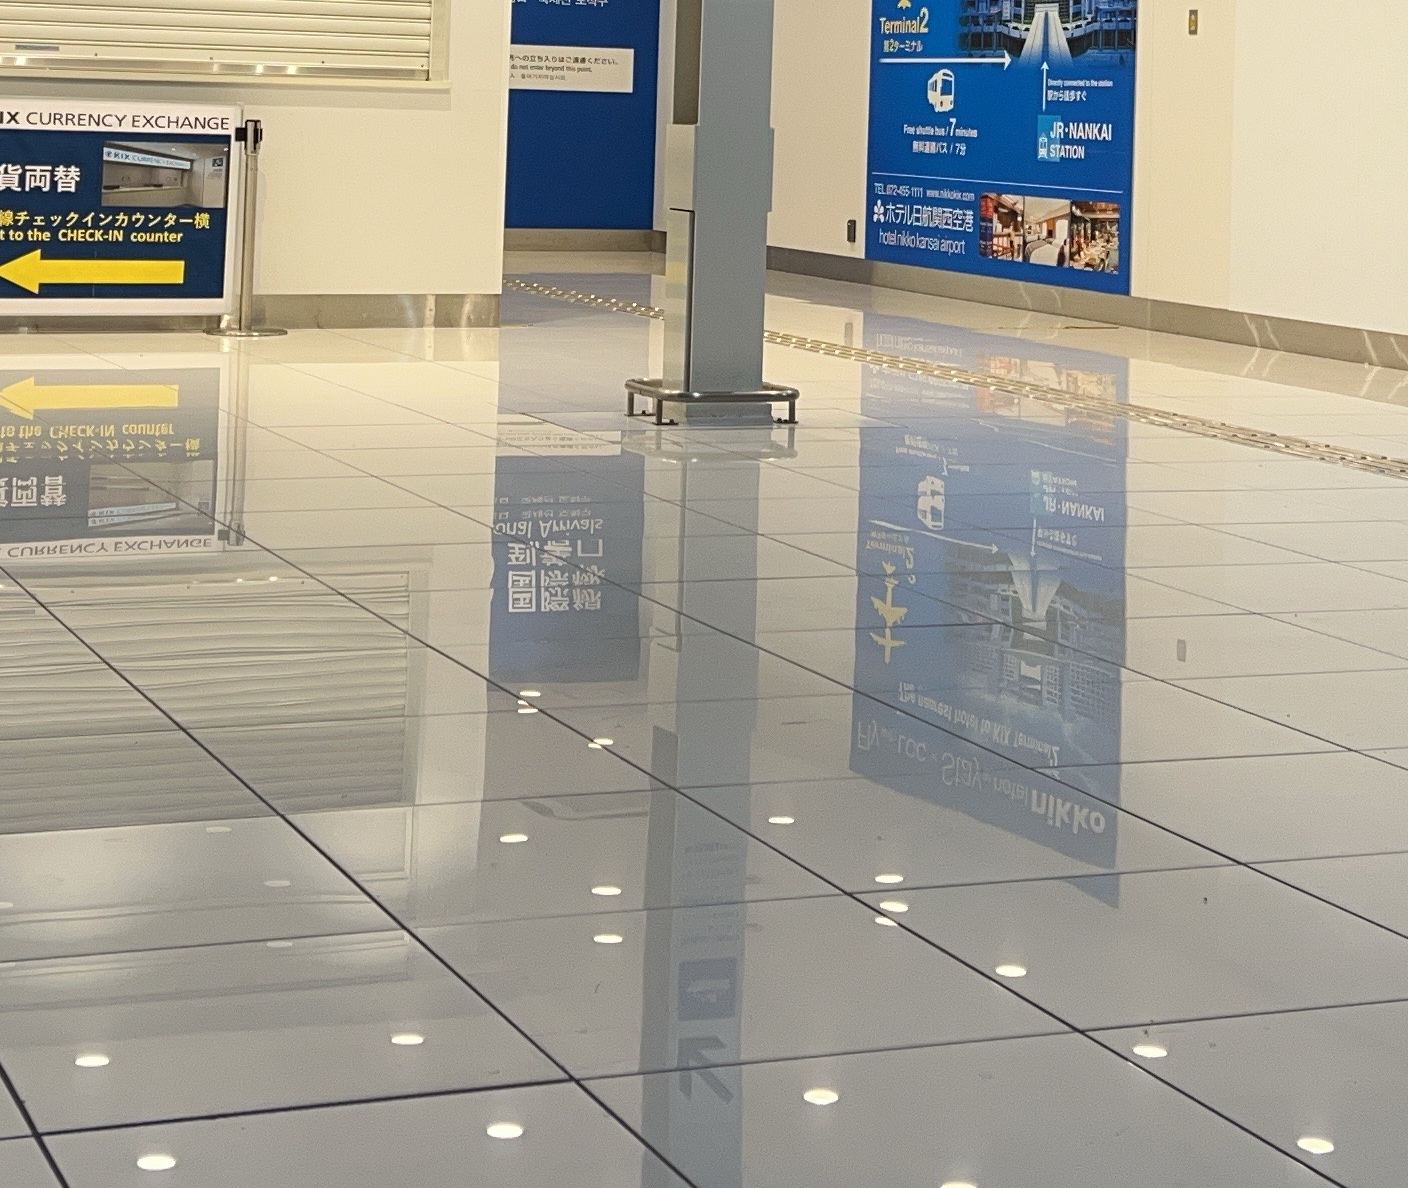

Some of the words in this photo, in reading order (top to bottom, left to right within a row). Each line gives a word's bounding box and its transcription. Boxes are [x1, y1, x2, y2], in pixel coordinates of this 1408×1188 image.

[879, 6, 929, 35] Terminal2
[25, 111, 128, 128] CURRENCY
[131, 114, 230, 131] EXCHANGE
[949, 117, 957, 137] 7
[1049, 144, 1085, 159] STATION
[885, 201, 974, 233] ホテル日航関西空港
[8, 229, 23, 242] to
[26, 228, 51, 242] the
[57, 229, 124, 242] CHECK-IN
[130, 230, 184, 243] counter
[878, 227, 897, 246] hotel
[916, 232, 940, 251] kansai
[940, 234, 966, 256] airport
